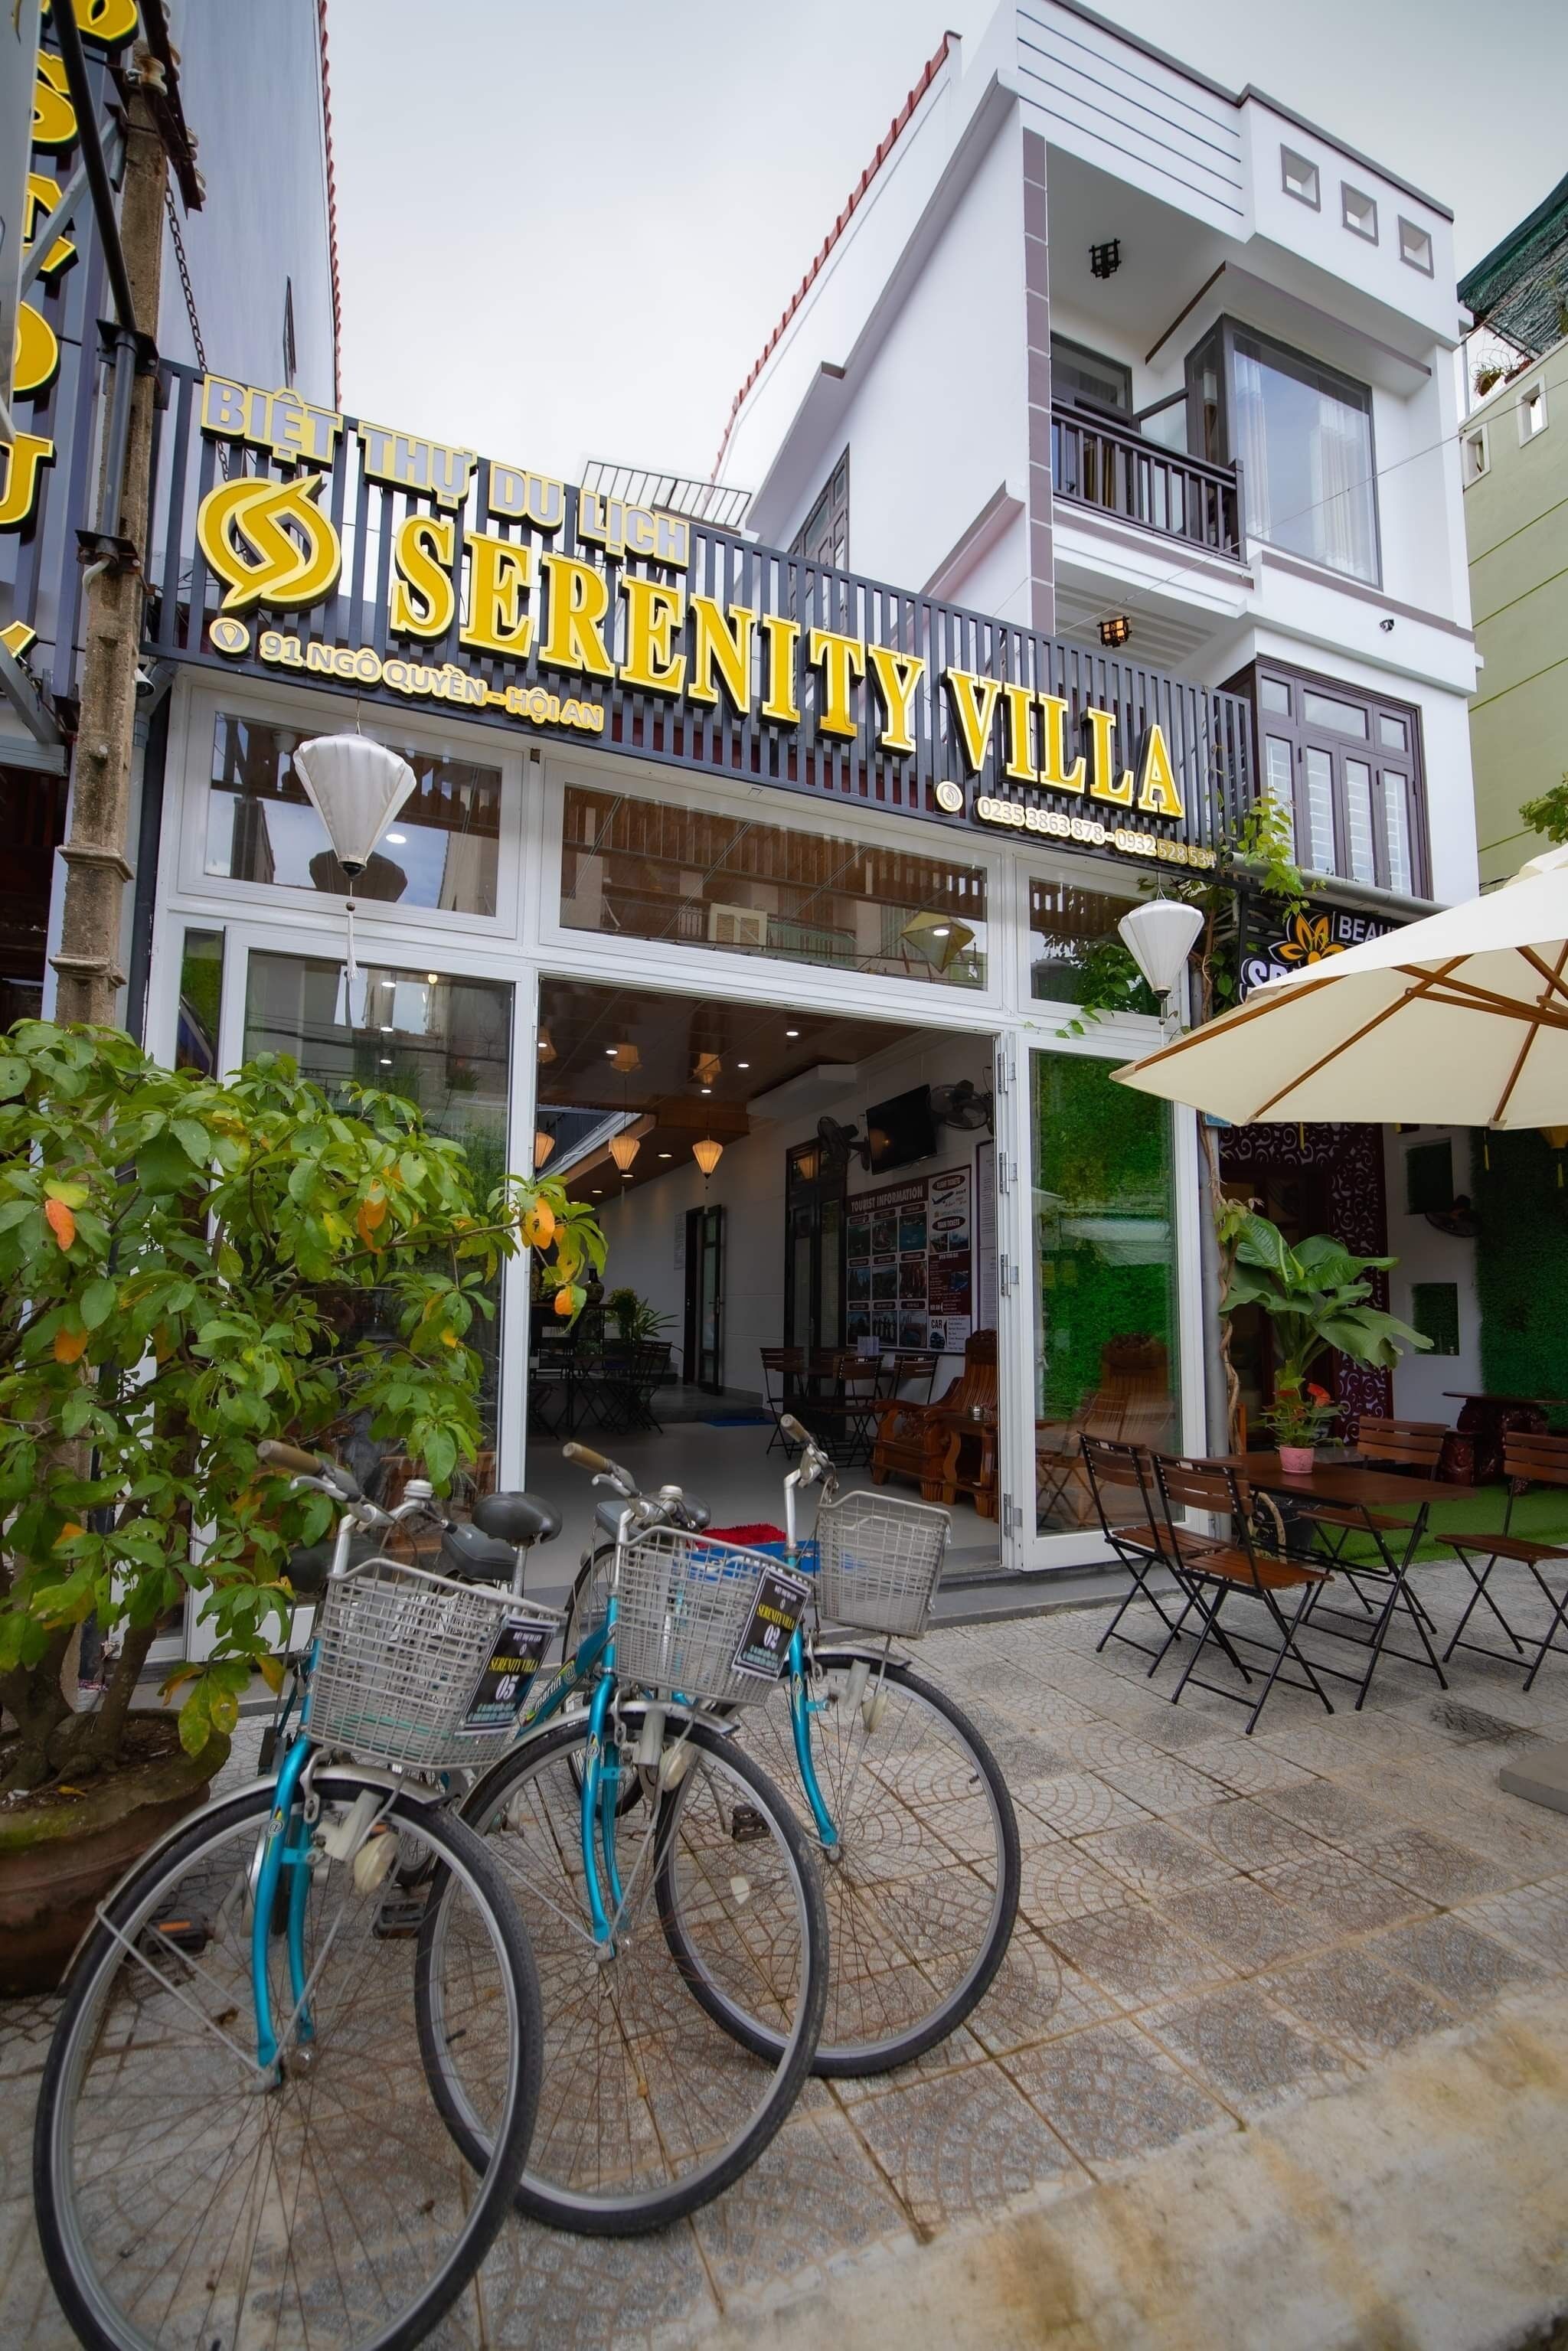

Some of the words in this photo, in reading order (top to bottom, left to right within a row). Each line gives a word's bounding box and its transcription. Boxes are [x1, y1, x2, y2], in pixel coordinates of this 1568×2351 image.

[201, 373, 343, 469] BIỆT
[358, 420, 478, 509] THỰ
[489, 461, 565, 531] DU
[578, 488, 691, 570] LỊCH
[308, 643, 381, 681] NGÔ
[384, 660, 486, 705] QUYỀN
[506, 687, 560, 723] HỘI
[560, 700, 603, 731] AN
[390, 514, 925, 755] SERENITY
[943, 666, 1185, 821] VILLA
[979, 798, 1024, 826] 0235
[1026, 808, 1070, 836] 3863
[1072, 819, 1104, 844] 878
[1116, 830, 1156, 855] 0932
[1158, 840, 1186, 864] 528
[1247, 959, 1301, 988] SP
[851, 1199, 875, 1212] TOURIST
[877, 1186, 923, 1209] INFORMATION
[931, 1319, 942, 1329] CAR
[495, 1674, 520, 1700] 05
